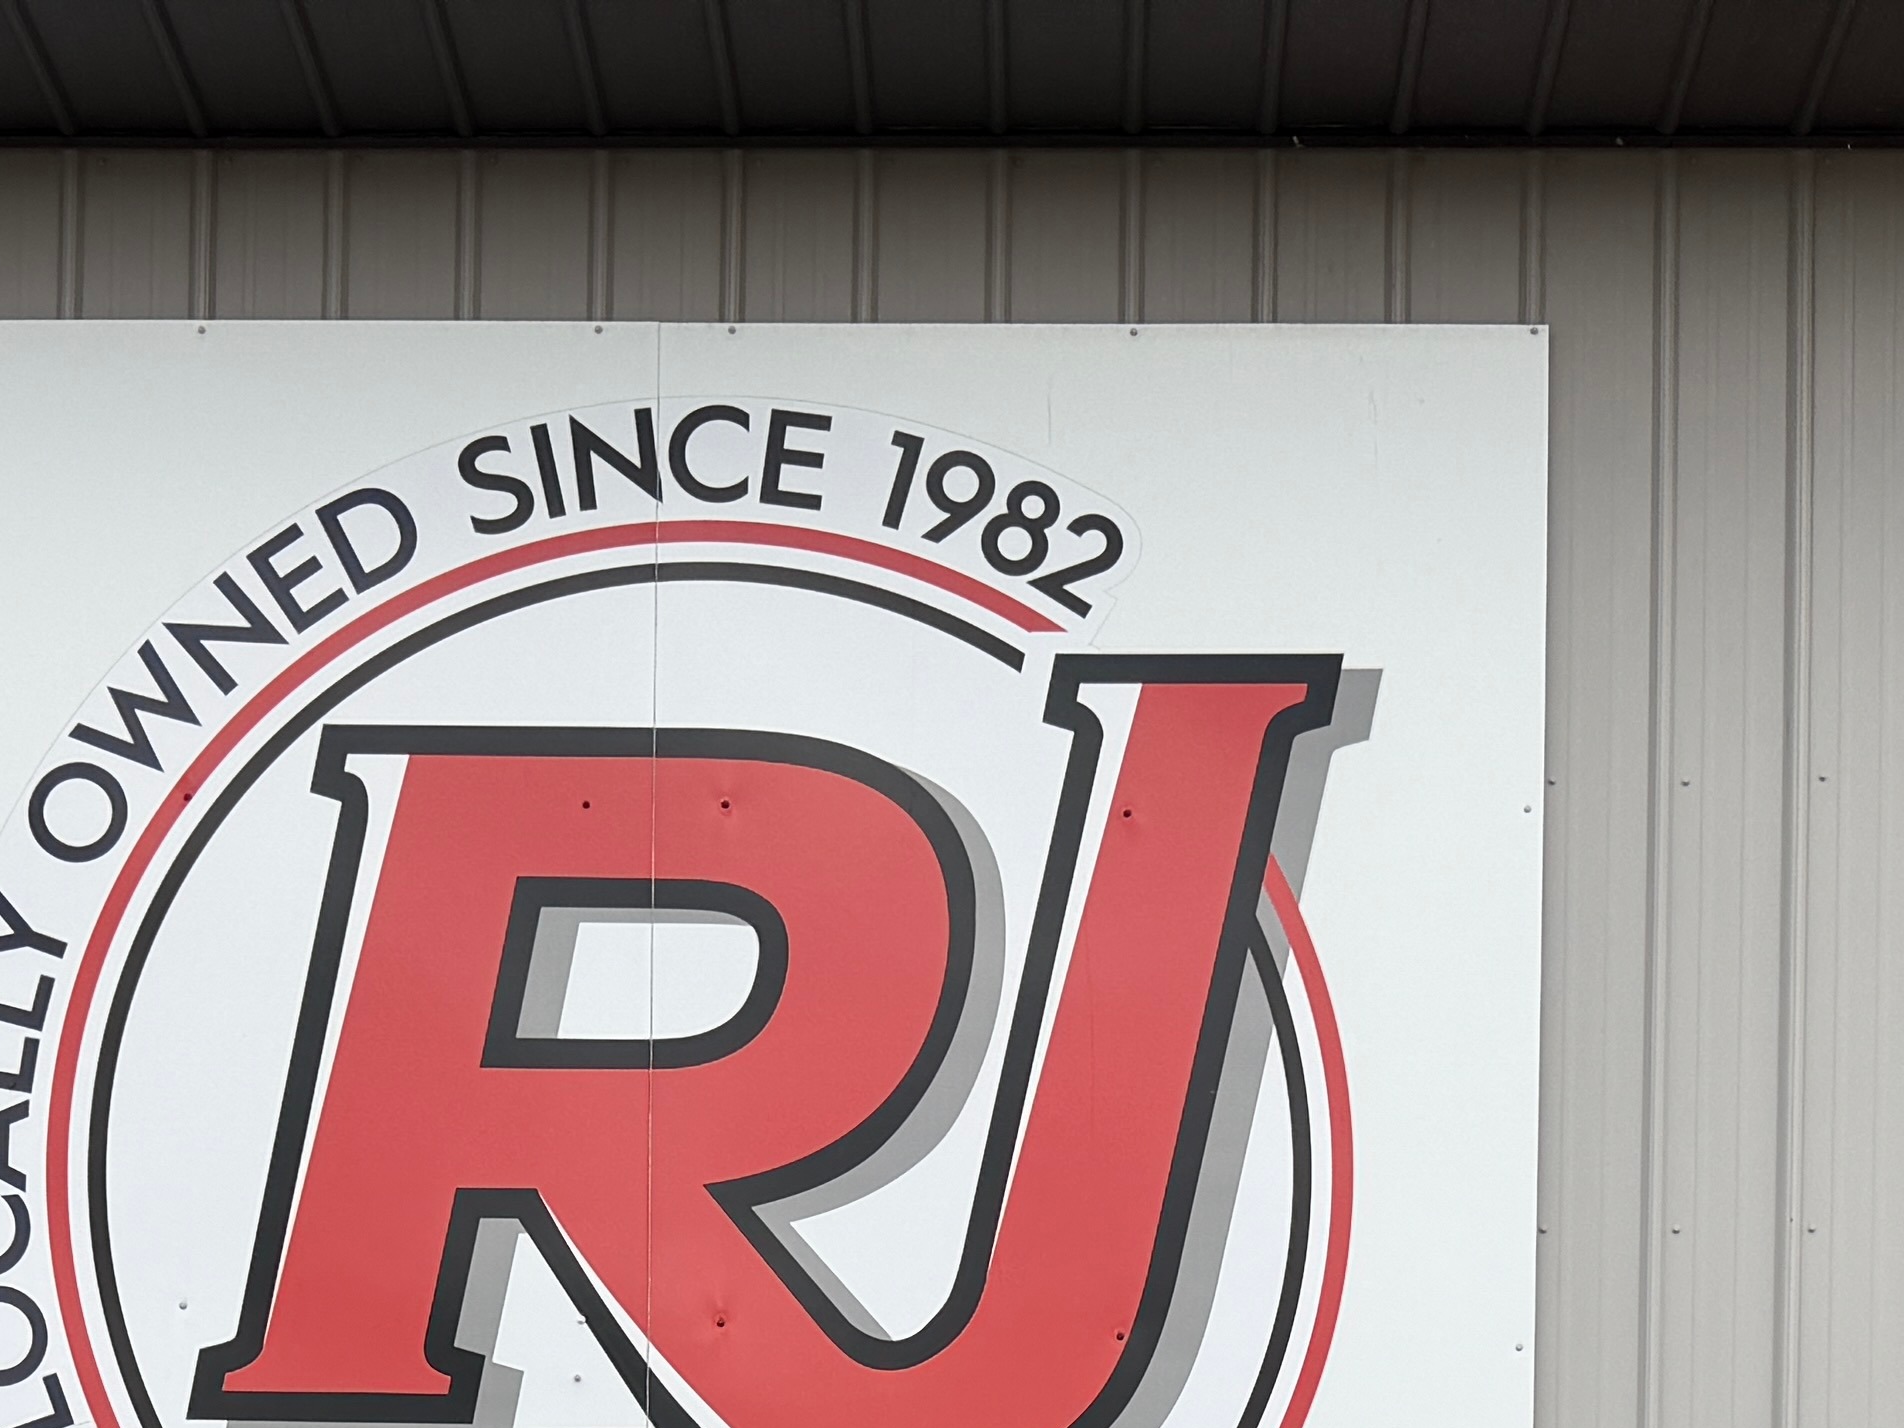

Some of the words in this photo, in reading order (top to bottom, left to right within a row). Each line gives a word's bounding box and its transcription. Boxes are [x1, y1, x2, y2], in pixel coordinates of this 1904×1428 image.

[29, 488, 417, 862] OWNED
[458, 405, 832, 535] SINCE
[883, 431, 1123, 618] 1982
